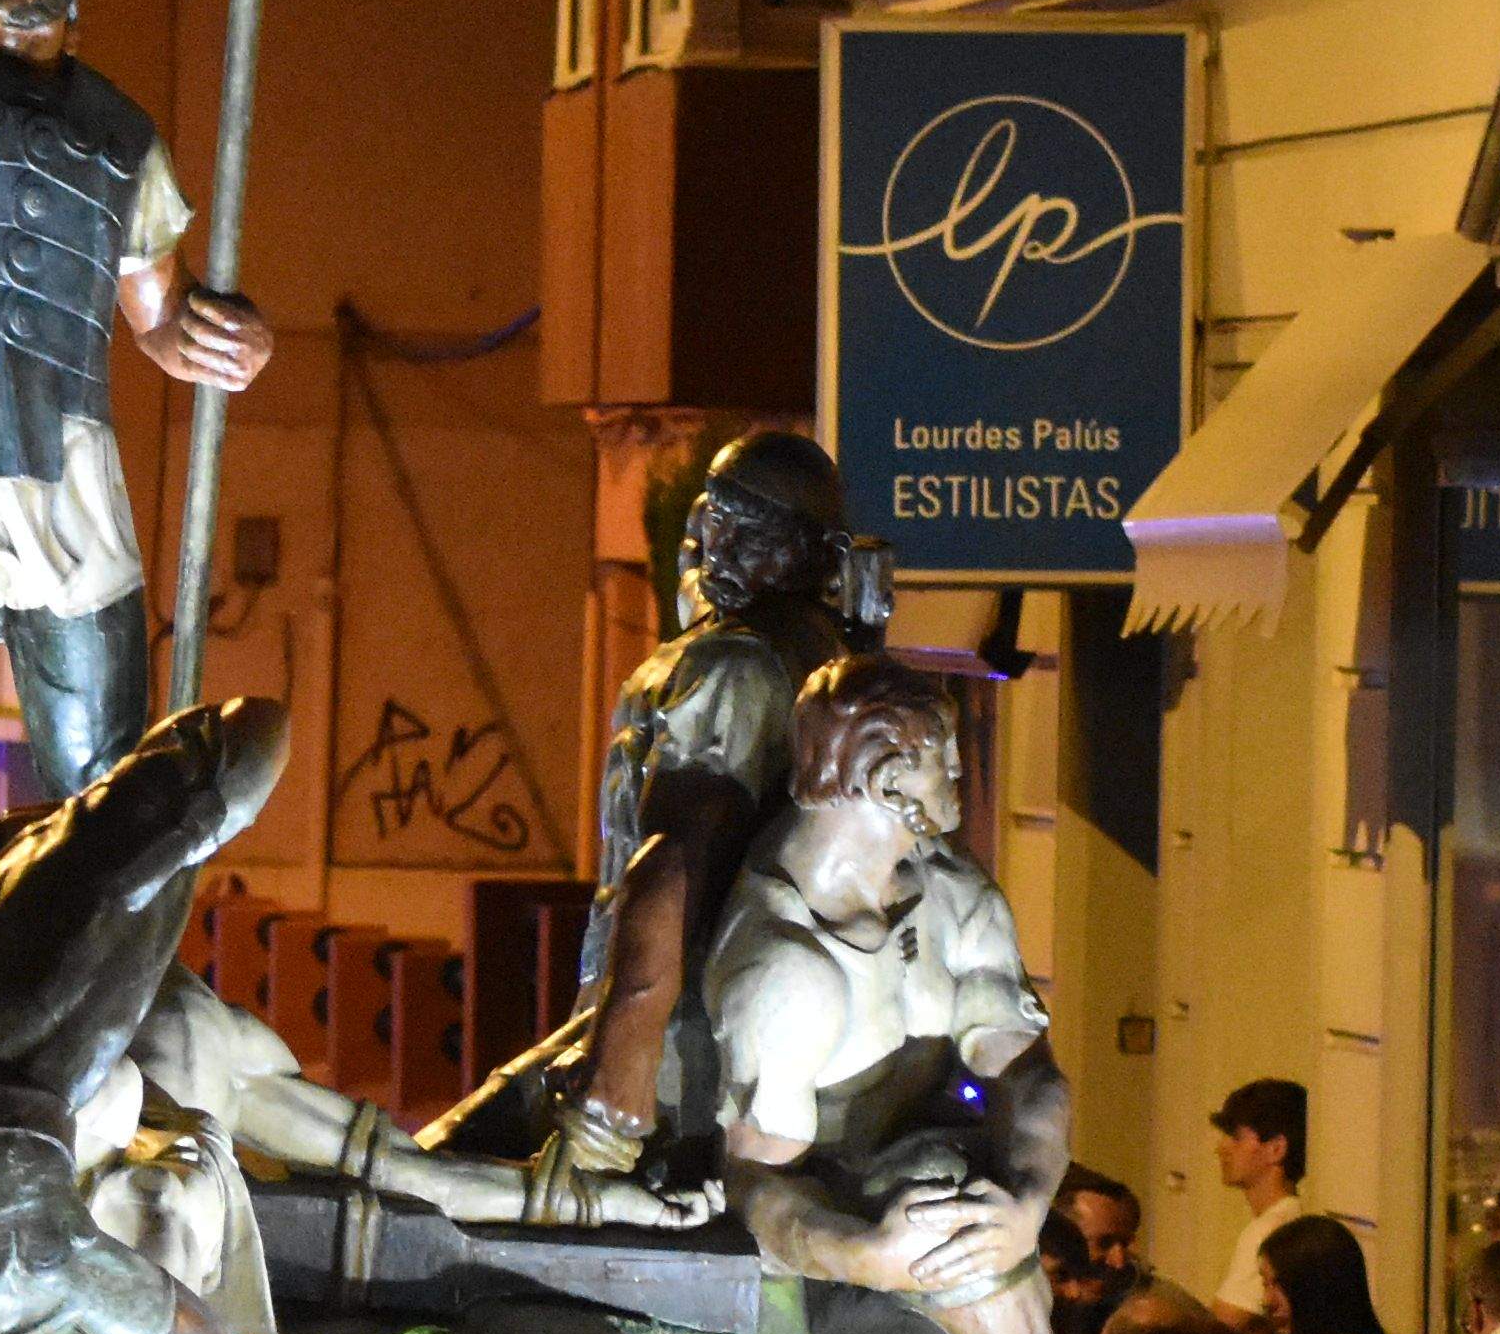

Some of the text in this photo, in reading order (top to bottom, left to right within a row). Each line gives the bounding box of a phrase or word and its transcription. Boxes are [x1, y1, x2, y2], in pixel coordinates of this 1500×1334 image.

[894, 418, 1121, 450] Lourdes Palús
[893, 476, 1121, 519] ESTILISTAS
